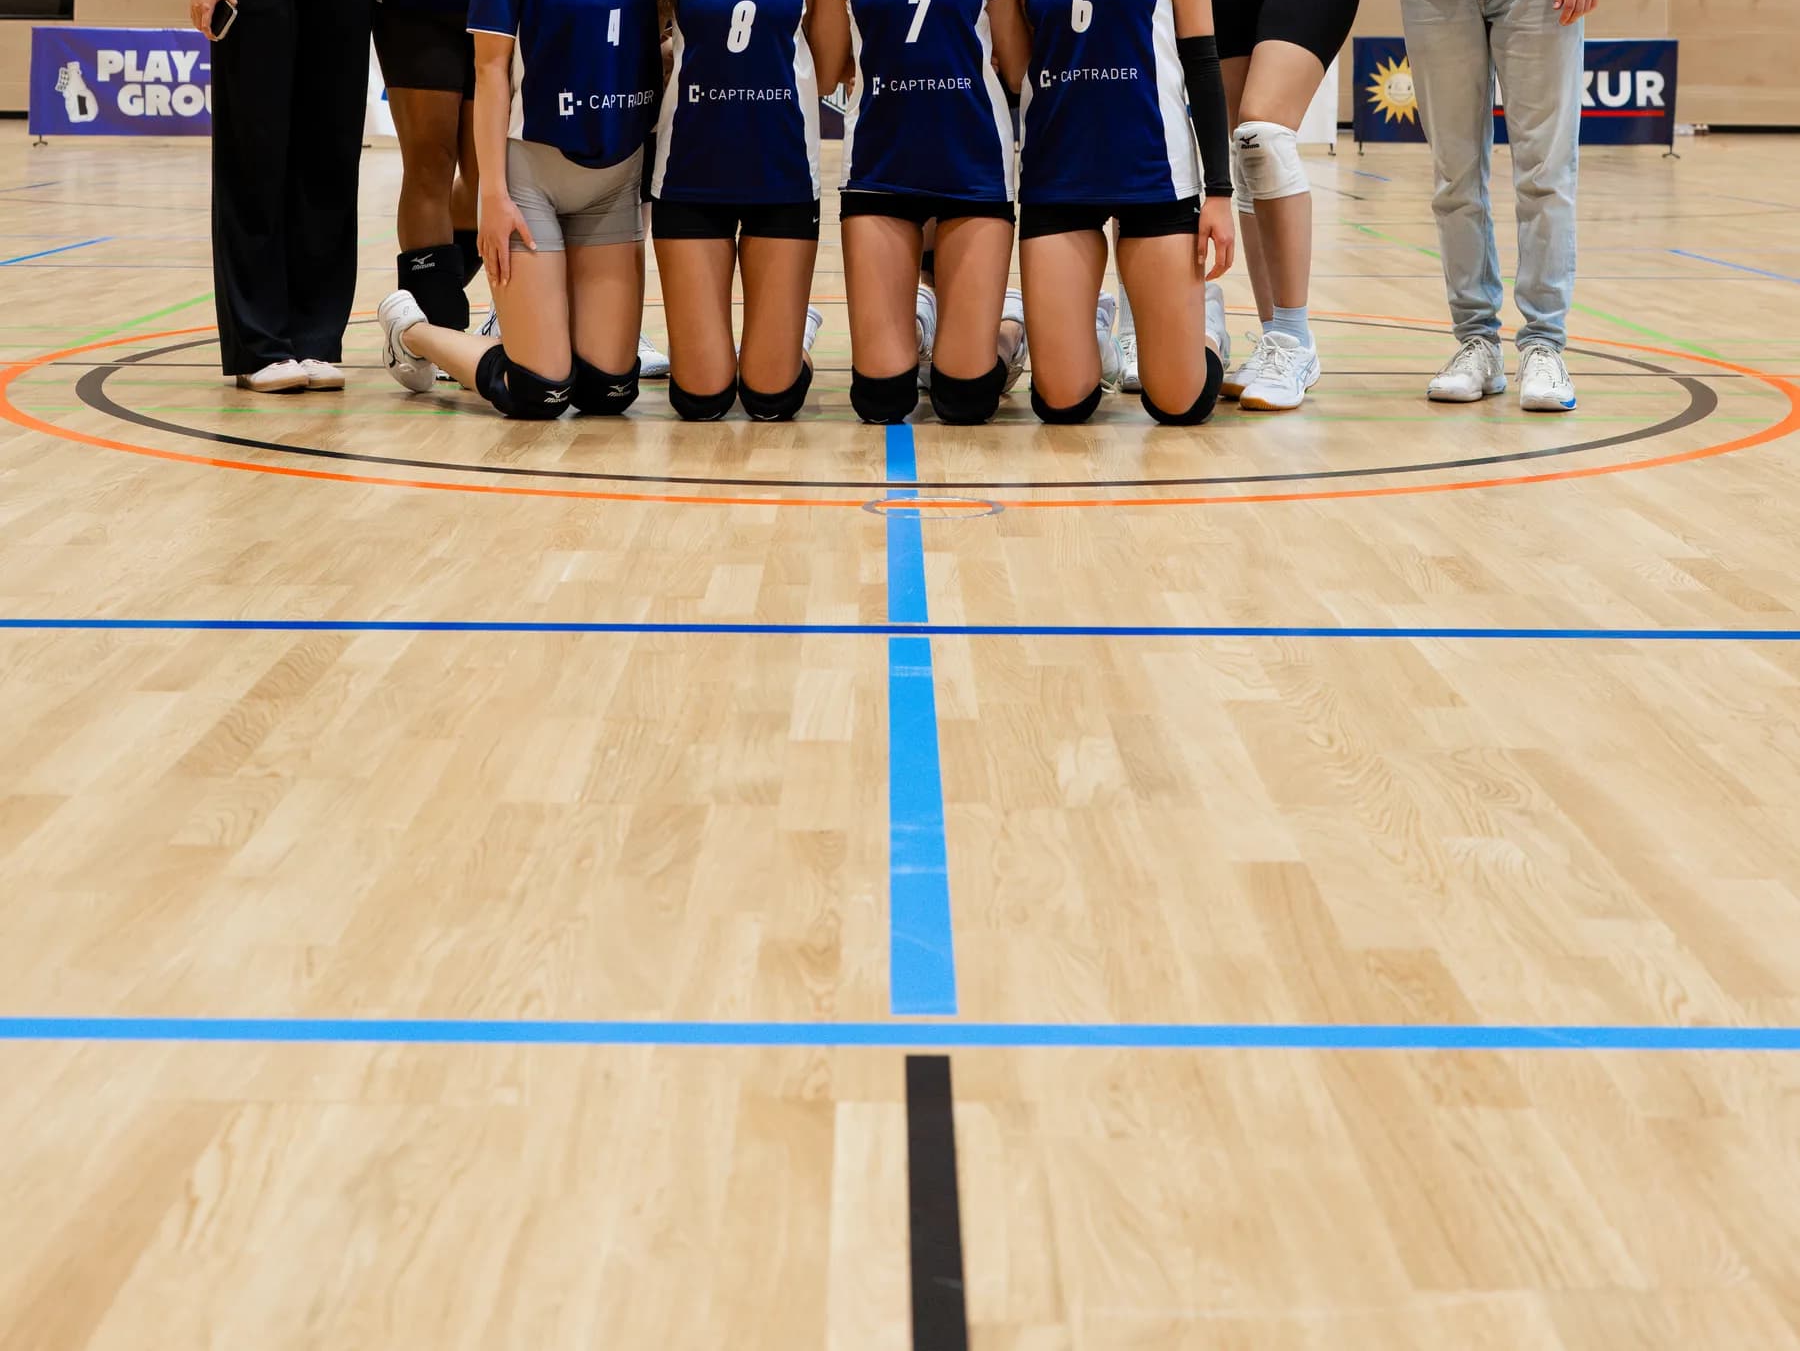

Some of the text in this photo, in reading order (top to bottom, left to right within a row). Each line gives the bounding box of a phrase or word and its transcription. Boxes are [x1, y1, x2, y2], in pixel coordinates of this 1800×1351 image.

[726, 0, 757, 54] 8
[1060, 67, 1138, 83] CAPTRADER
[890, 77, 972, 92] CAPTRADER
[709, 88, 792, 101] CAPTRADER
